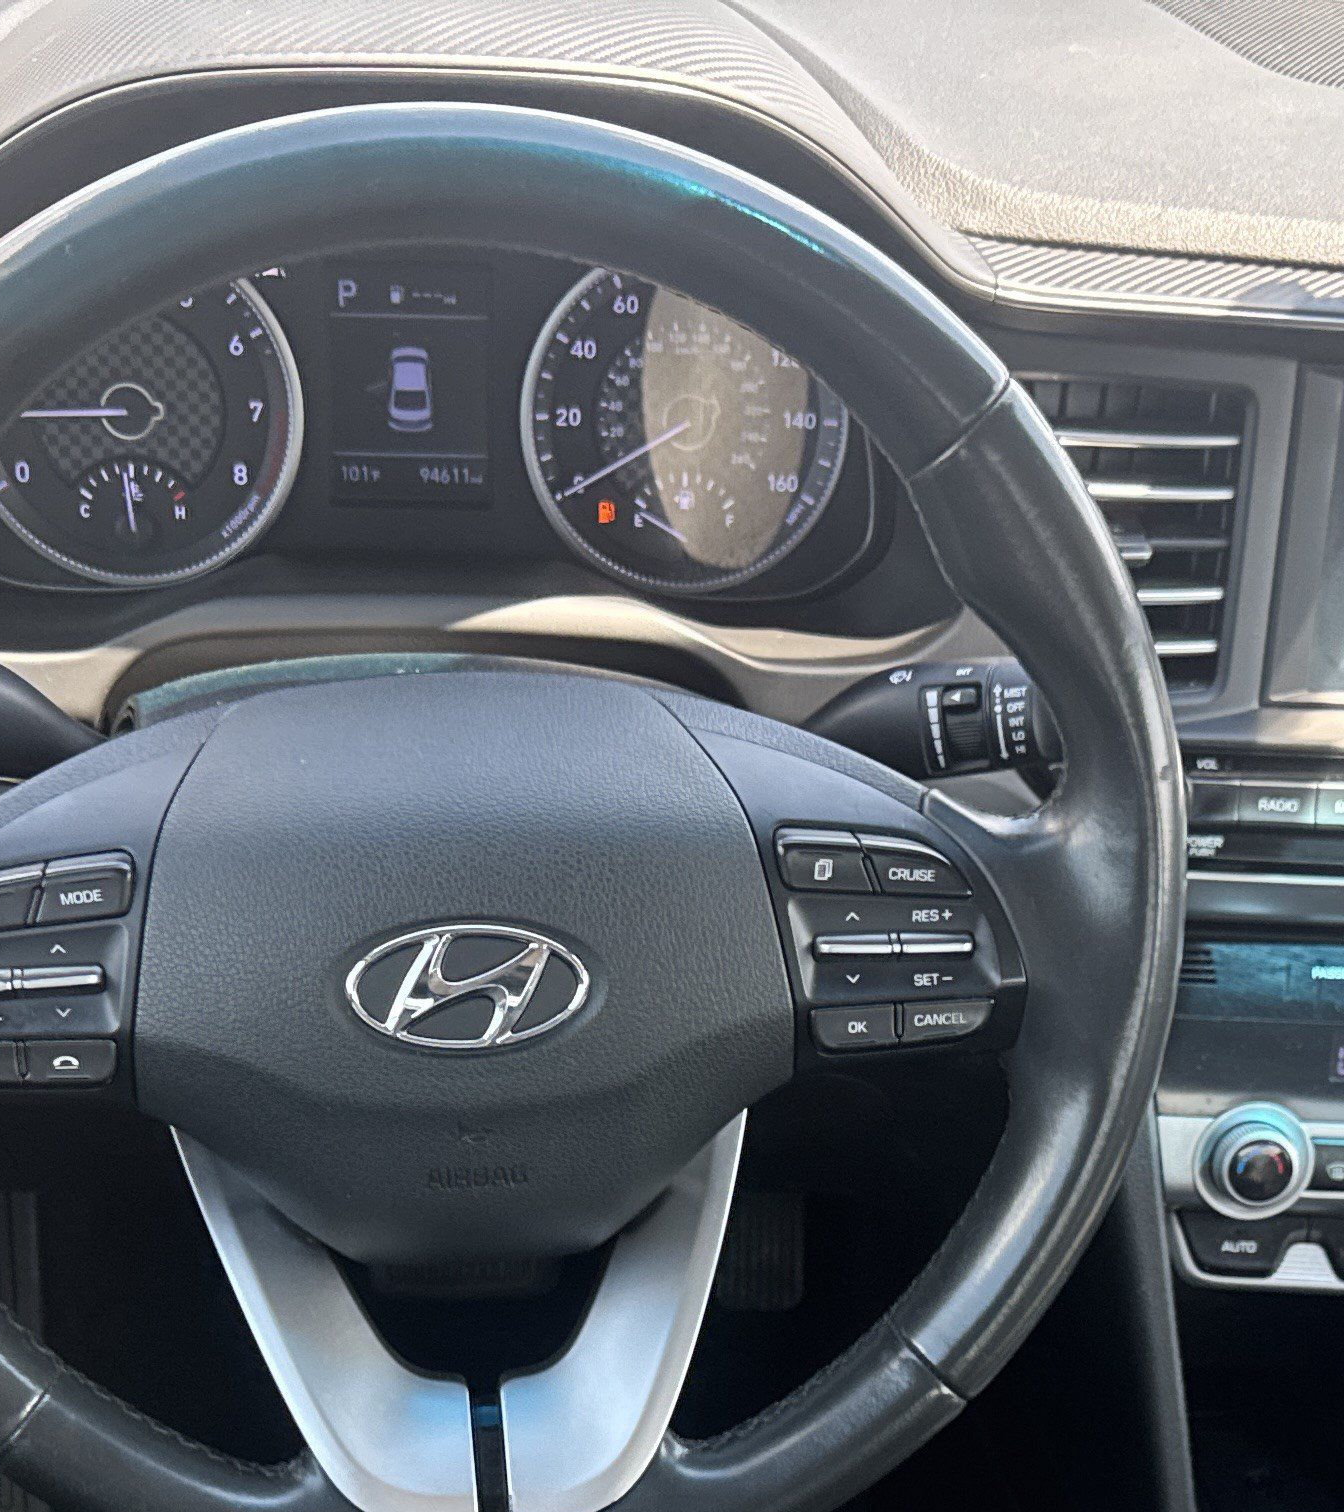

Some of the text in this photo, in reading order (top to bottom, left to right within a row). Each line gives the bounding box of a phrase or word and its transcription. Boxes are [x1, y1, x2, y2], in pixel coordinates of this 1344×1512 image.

[337, 279, 357, 307] P
[613, 295, 639, 314] 60
[228, 335, 244, 356] 6
[570, 340, 597, 360] 40
[249, 401, 263, 422] 7
[556, 408, 581, 427] 20
[783, 411, 816, 430] 140
[15, 461, 30, 483] 0
[233, 463, 248, 486] 8
[767, 475, 798, 493] 160
[79, 504, 91, 518] C
[175, 505, 186, 519] H
[1004, 687, 1028, 699] MIST
[1006, 702, 1026, 713] OFF
[1196, 758, 1219, 771] VOL
[1258, 796, 1300, 813] RADIO
[889, 868, 936, 882] CRUISE
[60, 889, 103, 905] MODE
[912, 909, 939, 922] RES
[914, 974, 938, 986] SET
[848, 1021, 867, 1033] OK
[914, 1012, 966, 1026] CANCEL
[428, 1164, 529, 1189] AIRBAG
[1221, 1240, 1257, 1253] AUTO
